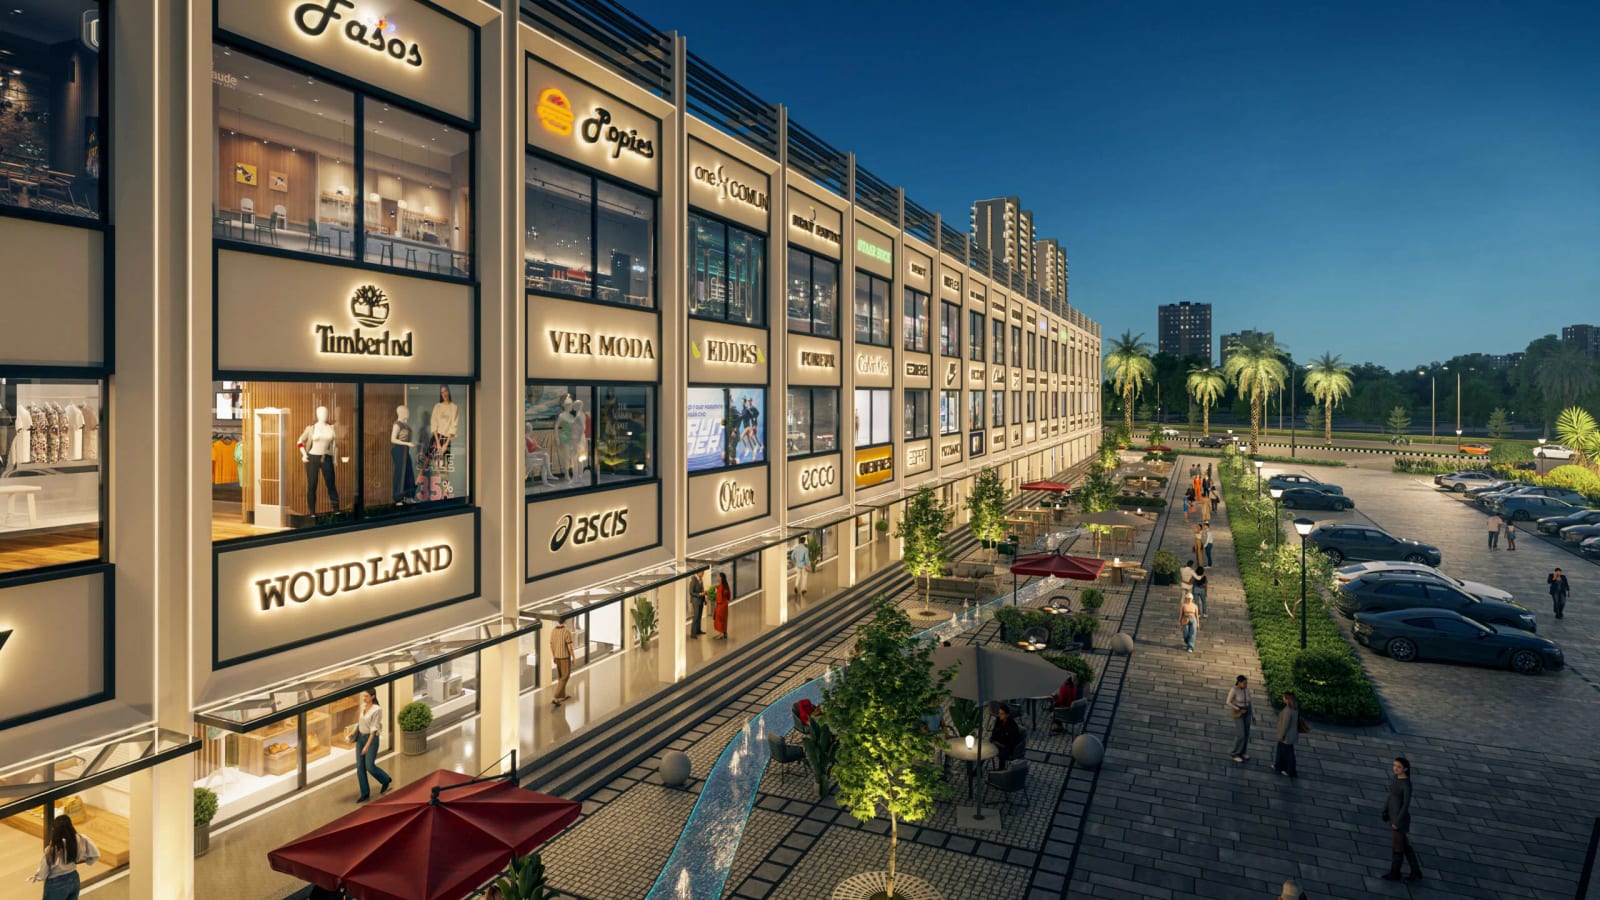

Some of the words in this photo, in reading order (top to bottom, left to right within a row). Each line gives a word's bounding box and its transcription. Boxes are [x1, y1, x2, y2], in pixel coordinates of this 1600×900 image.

[581, 107, 654, 159] Popies
[548, 330, 593, 355] VER
[599, 335, 655, 360] MODA
[707, 340, 758, 364] EDDES
[255, 544, 453, 611] WOUDLAND
